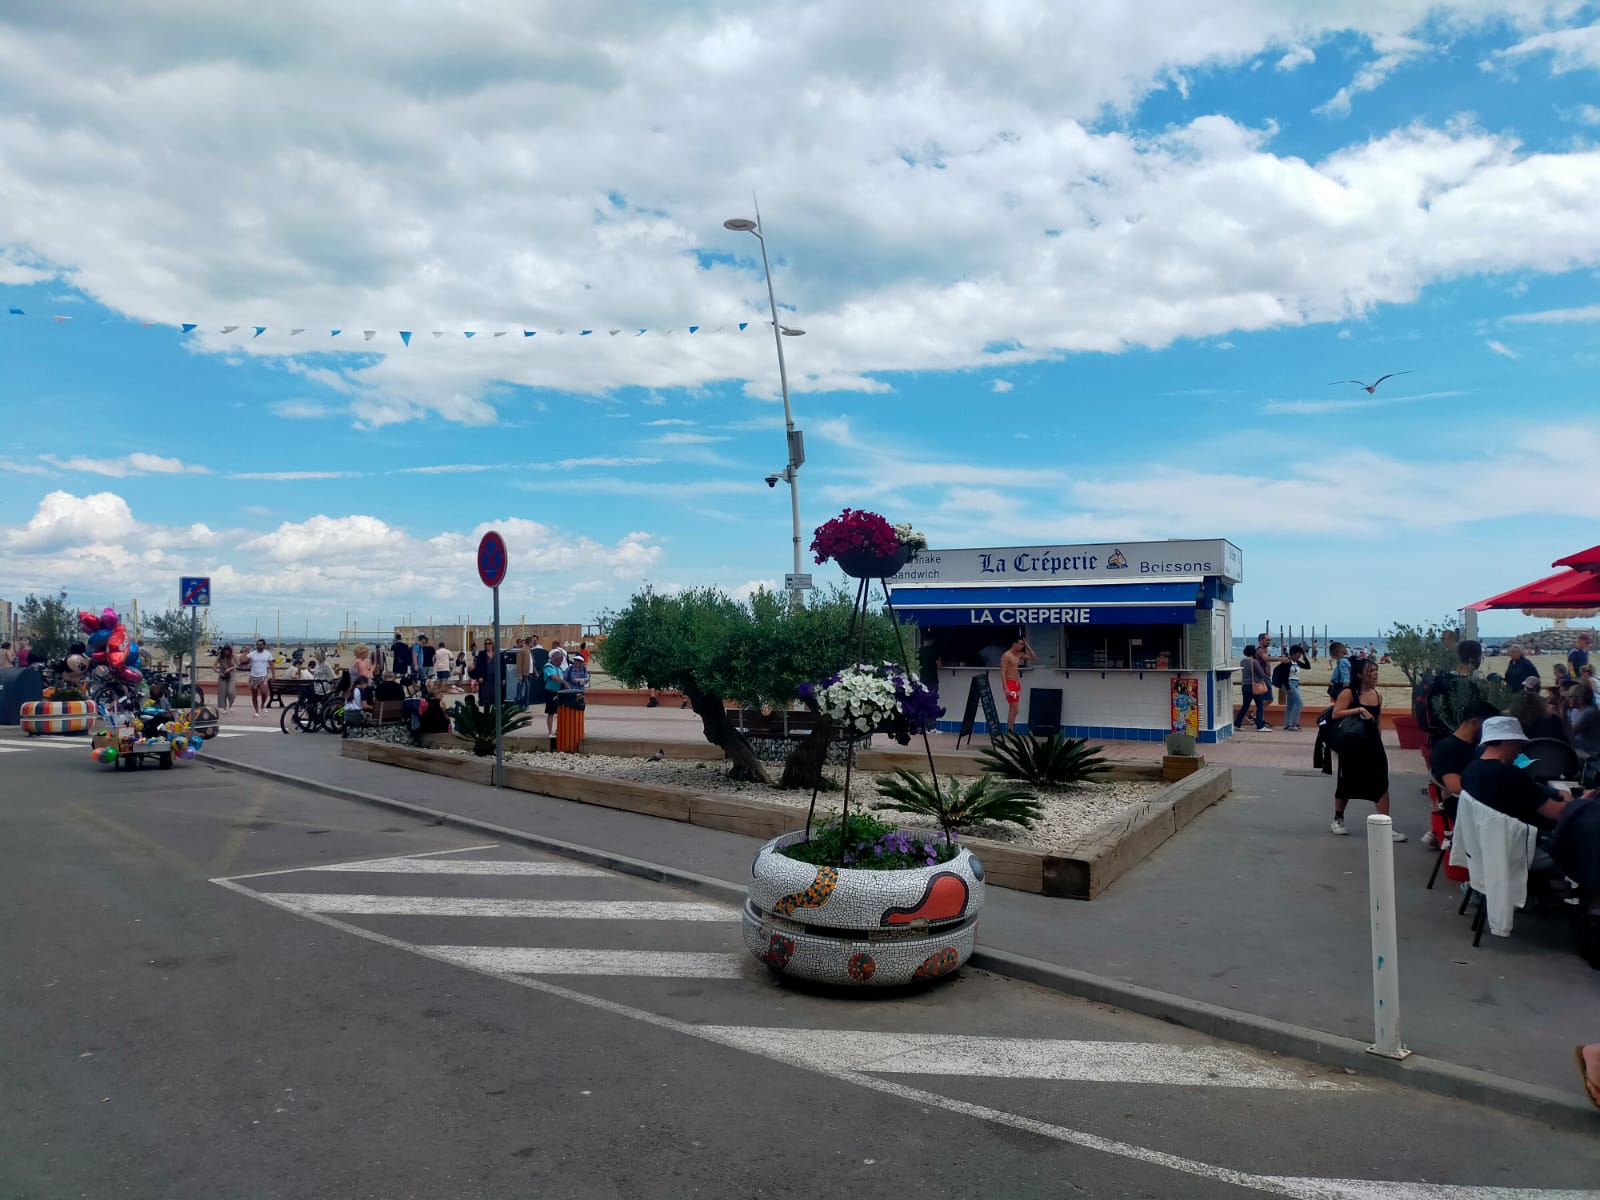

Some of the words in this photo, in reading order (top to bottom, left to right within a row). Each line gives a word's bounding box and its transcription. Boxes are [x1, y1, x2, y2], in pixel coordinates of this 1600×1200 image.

[978, 553, 1006, 573] La
[1140, 560, 1212, 573] Boissons
[970, 609, 994, 623] LA
[999, 608, 1091, 624] CREPERIE
